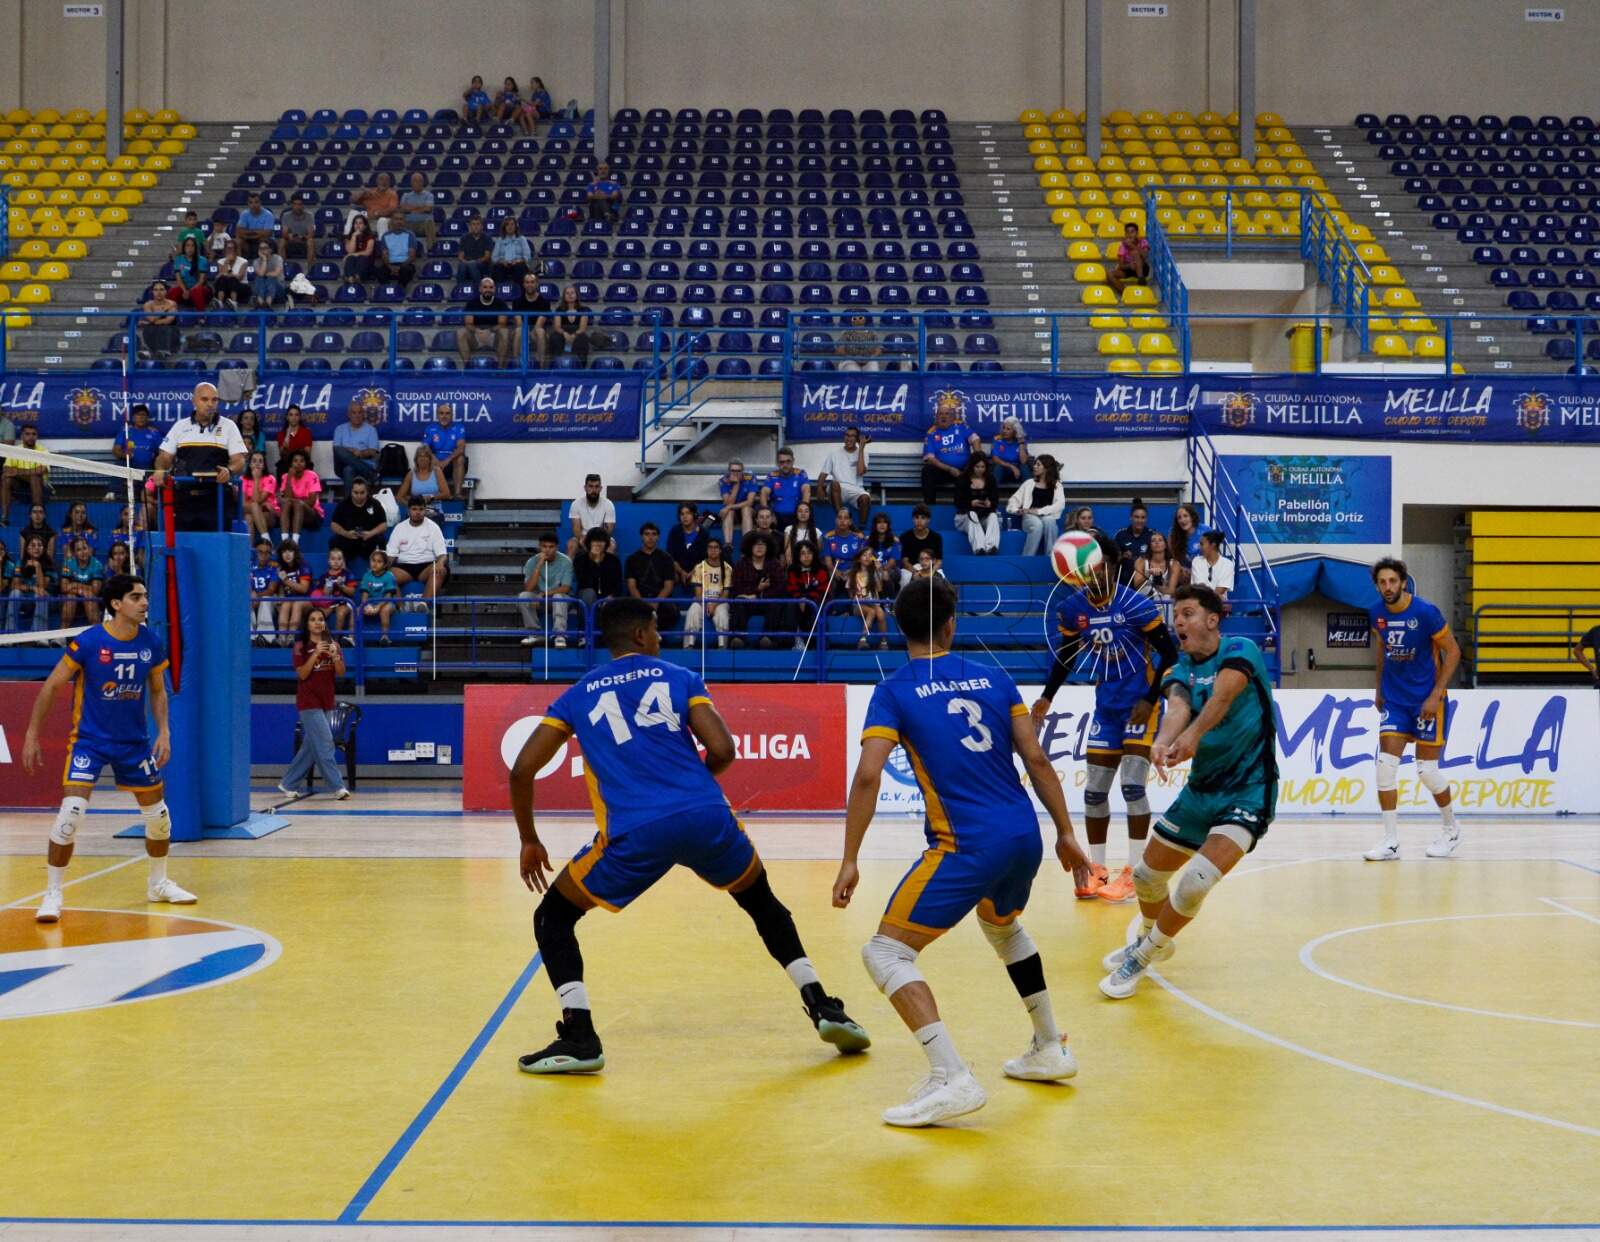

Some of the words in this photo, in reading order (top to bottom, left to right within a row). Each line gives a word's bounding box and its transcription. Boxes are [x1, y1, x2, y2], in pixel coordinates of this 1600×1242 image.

[149, 389, 194, 400] AUTÓNO
[395, 391, 432, 401] CIUDAD
[434, 389, 492, 401] AUTÓNOMA
[512, 382, 621, 412] MELILLA
[802, 384, 908, 412] MELILLA
[974, 393, 1010, 402] CIUDAD
[1013, 391, 1073, 402] AUTÓNOMA
[1094, 383, 1200, 412] MELILLA
[1264, 394, 1301, 403] CIUDAD
[1384, 385, 1493, 414] MELILLA
[1558, 396, 1594, 404] CIUDAD
[397, 402, 492, 422] MELLLA
[1266, 405, 1363, 424] MELILLA
[943, 434, 955, 446] 87
[1290, 473, 1344, 485] MELILLA
[1278, 499, 1330, 510] Pabellón
[1283, 511, 1332, 522] Imbroda
[841, 544, 848, 553] 6
[253, 576, 267, 589] 13
[709, 573, 719, 583] 15
[1090, 627, 1114, 643] 20
[1329, 630, 1369, 642] MELILLA
[1387, 630, 1405, 645] 87
[114, 663, 136, 680] 11
[586, 667, 664, 693] MORENO
[587, 681, 681, 746] 14
[947, 697, 994, 753] 3
[730, 733, 811, 760] RLIGA
[1280, 777, 1366, 808] IUDAD
